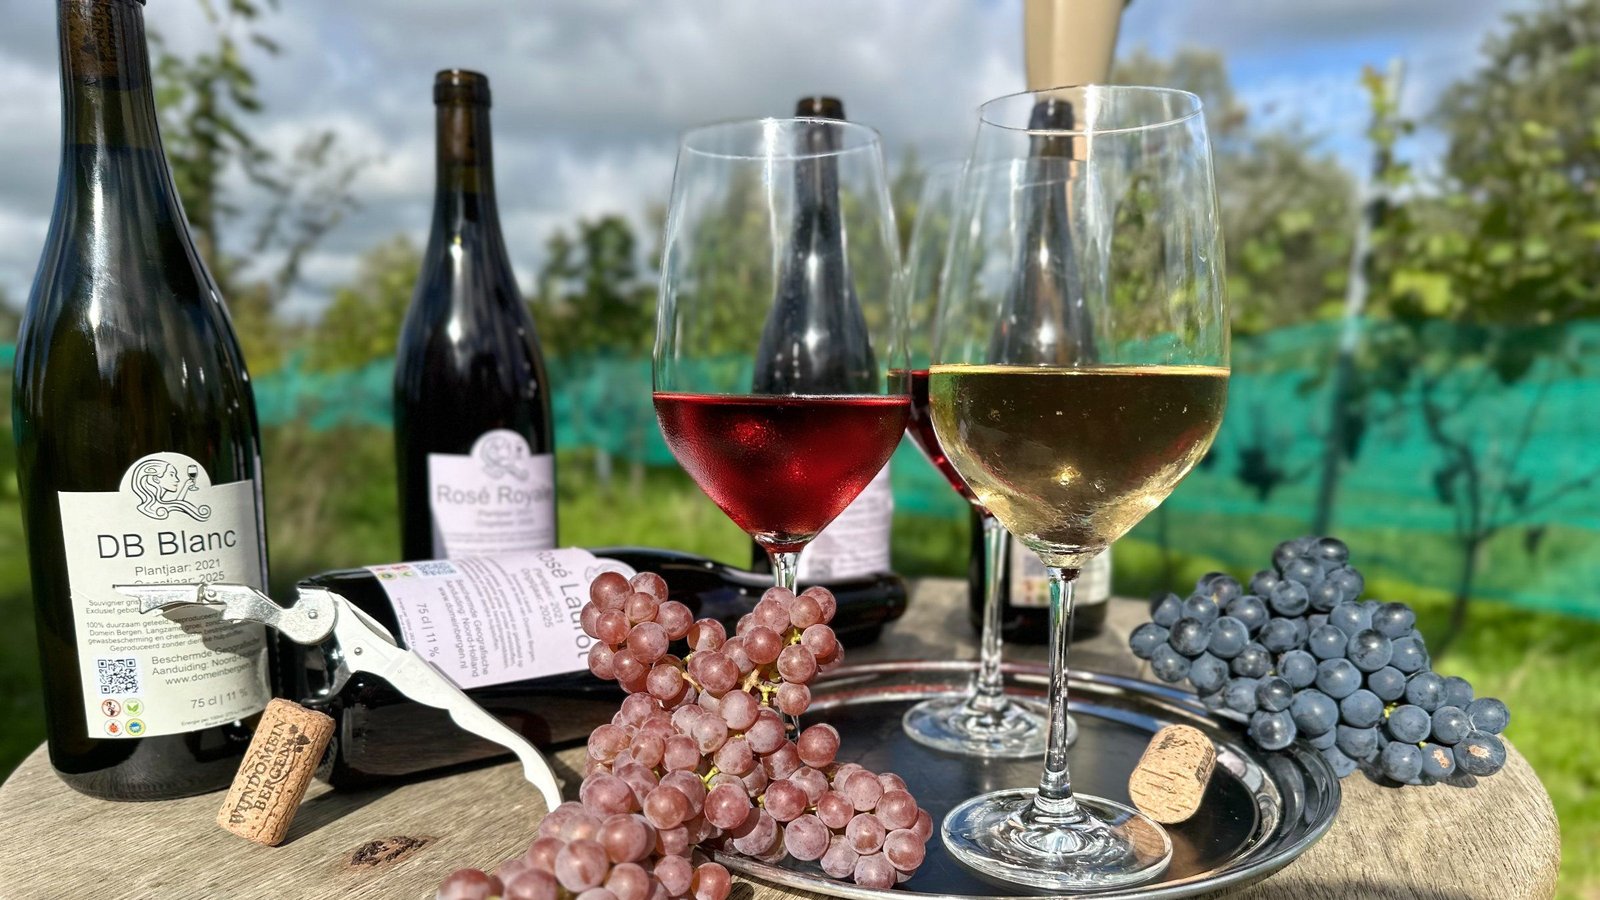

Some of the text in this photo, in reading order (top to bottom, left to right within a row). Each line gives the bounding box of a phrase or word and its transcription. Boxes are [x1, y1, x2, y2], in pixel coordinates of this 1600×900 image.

[437, 485, 490, 505] Rosé
[97, 529, 237, 559] DB Blanc
[135, 558, 221, 576] Plantjaar: 2021
[199, 571, 225, 584] 2025
[86, 607, 115, 615] Exclusief
[89, 599, 124, 607] Souvignier
[417, 603, 429, 615] 75
[539, 605, 553, 628] 2025
[550, 601, 564, 623] 2021
[90, 629, 115, 637] Domein
[438, 587, 468, 669] www.domeinbergen.nl
[88, 635, 153, 645] gewasbescherming
[155, 634, 165, 642] en
[109, 642, 160, 652] Geproduceerd
[162, 640, 186, 649] zonder
[426, 633, 437, 643] 11
[429, 647, 440, 658] %
[462, 617, 478, 678] Noord-Holland
[473, 620, 488, 675] Geografische
[152, 649, 212, 665] Beschermde
[152, 661, 210, 676] Aanduiding:
[191, 698, 205, 709] 75
[208, 695, 217, 706] cl
[226, 690, 236, 701] 11
[228, 719, 287, 824] WIJNDOMEIN
[253, 741, 293, 813] BERGEN
